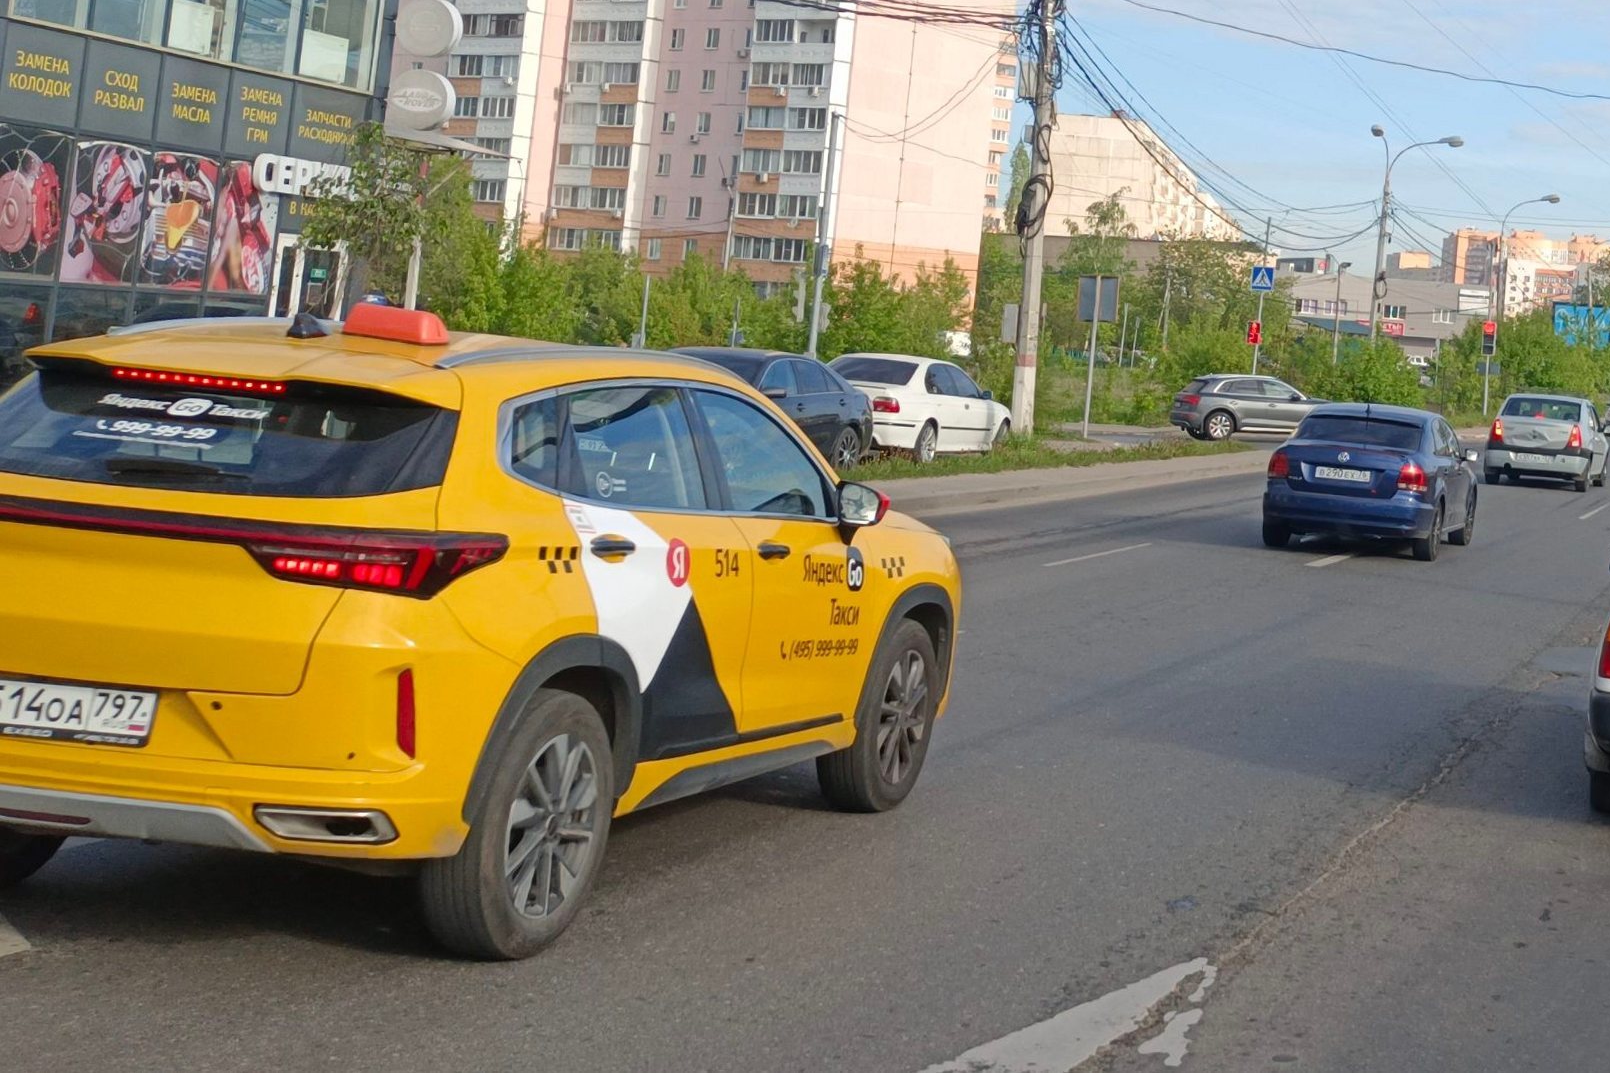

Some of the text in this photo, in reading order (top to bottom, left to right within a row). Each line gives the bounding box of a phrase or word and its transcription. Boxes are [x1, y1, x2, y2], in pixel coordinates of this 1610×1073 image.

[15, 50, 70, 75] ЗАМЕНА
[8, 72, 72, 99] КОЛОДОК
[104, 70, 139, 93] СХОД
[94, 91, 145, 113] РАЗВАЛ
[171, 83, 217, 105] ЗАМЕНА
[240, 86, 283, 107] ЗАМЕНА
[172, 104, 211, 124] МАСЛА
[242, 108, 278, 126] РЕМНЯ
[306, 109, 352, 129] ЗАПЧАСТИ
[246, 127, 269, 144] ГРМ
[97, 393, 171, 411] Яндекс
[208, 403, 271, 420] Такси
[109, 420, 217, 440] 999-99-99
[671, 544, 686, 581] Я
[715, 548, 740, 578] 514
[803, 554, 844, 586] Яндекс
[830, 598, 860, 626] Такси
[789, 638, 859, 661] (495) 999-99-99
[0, 684, 144, 725] 14ОА 797
